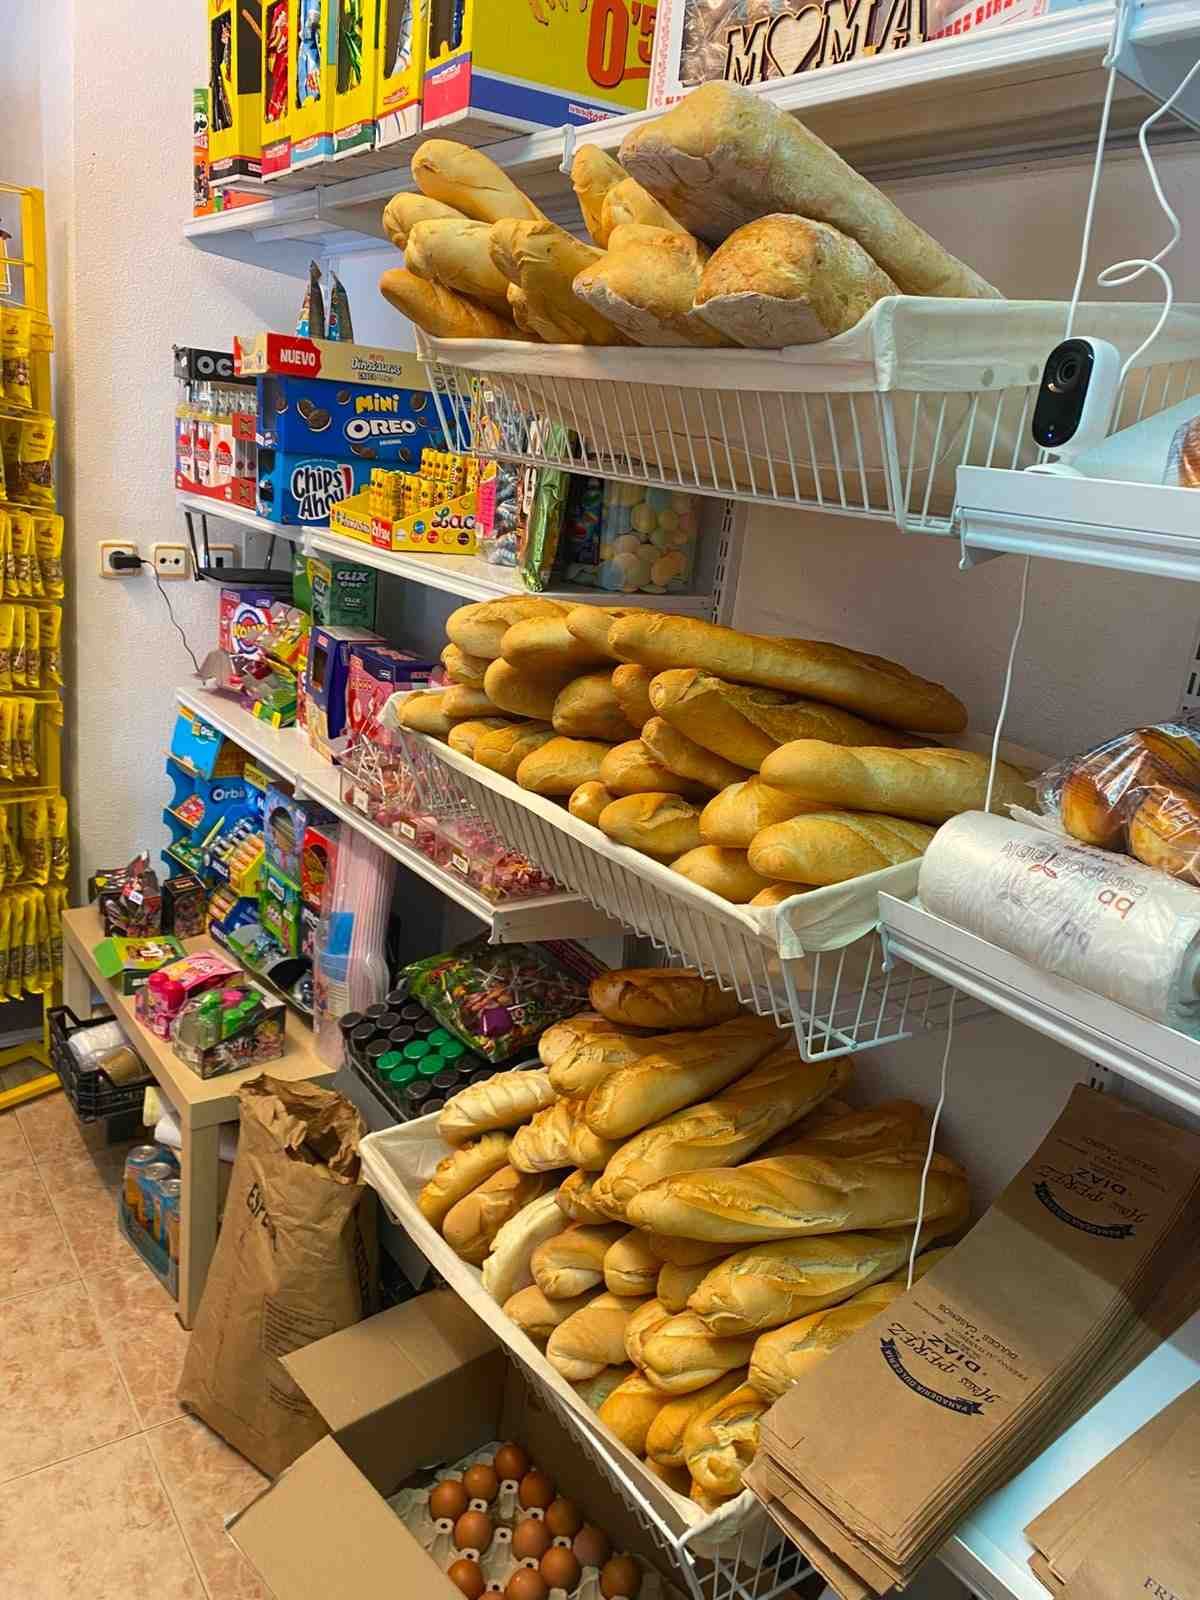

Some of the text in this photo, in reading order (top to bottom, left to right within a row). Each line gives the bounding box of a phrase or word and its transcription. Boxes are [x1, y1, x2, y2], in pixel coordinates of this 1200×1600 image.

[280, 348, 316, 367] NUEVO
[346, 418, 416, 441] OREO
[293, 466, 342, 499] Chips
[885, 1321, 959, 1374] PEREZ
[926, 1333, 981, 1373] DIAZ
